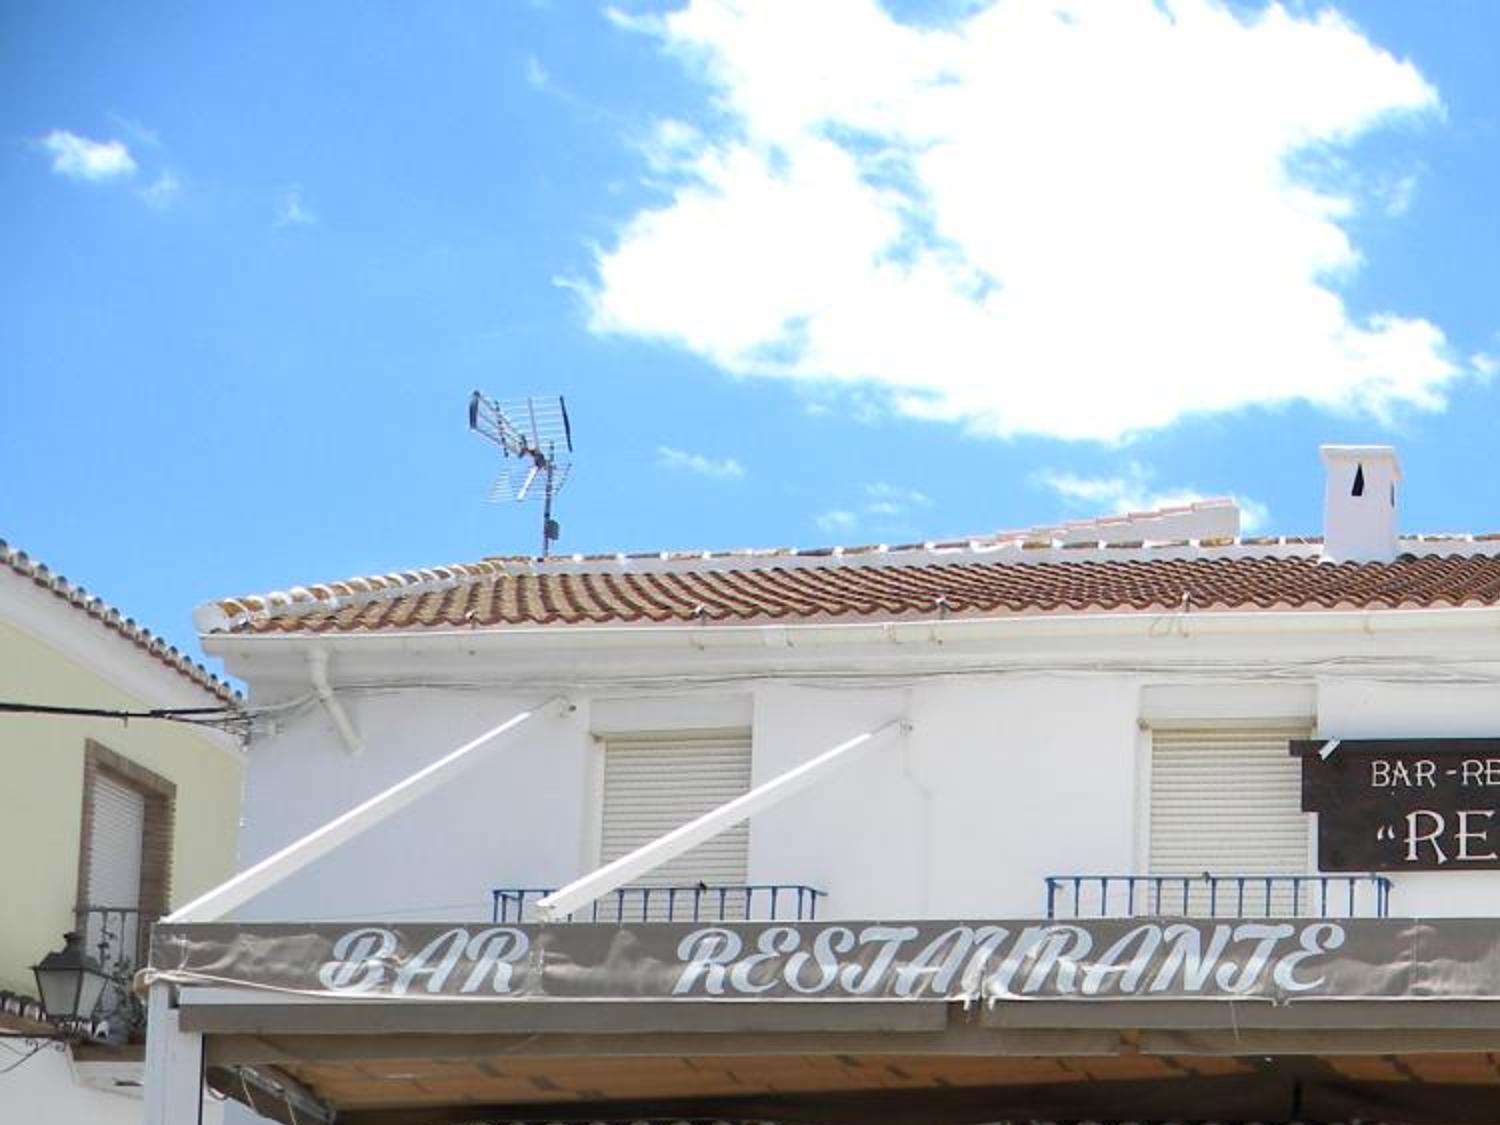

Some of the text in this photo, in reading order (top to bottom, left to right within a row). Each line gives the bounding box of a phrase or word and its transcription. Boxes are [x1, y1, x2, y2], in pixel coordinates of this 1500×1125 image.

[1371, 761, 1436, 788] BAR
[318, 927, 529, 994] BAR
[673, 923, 1344, 995] RESTAURANTE
